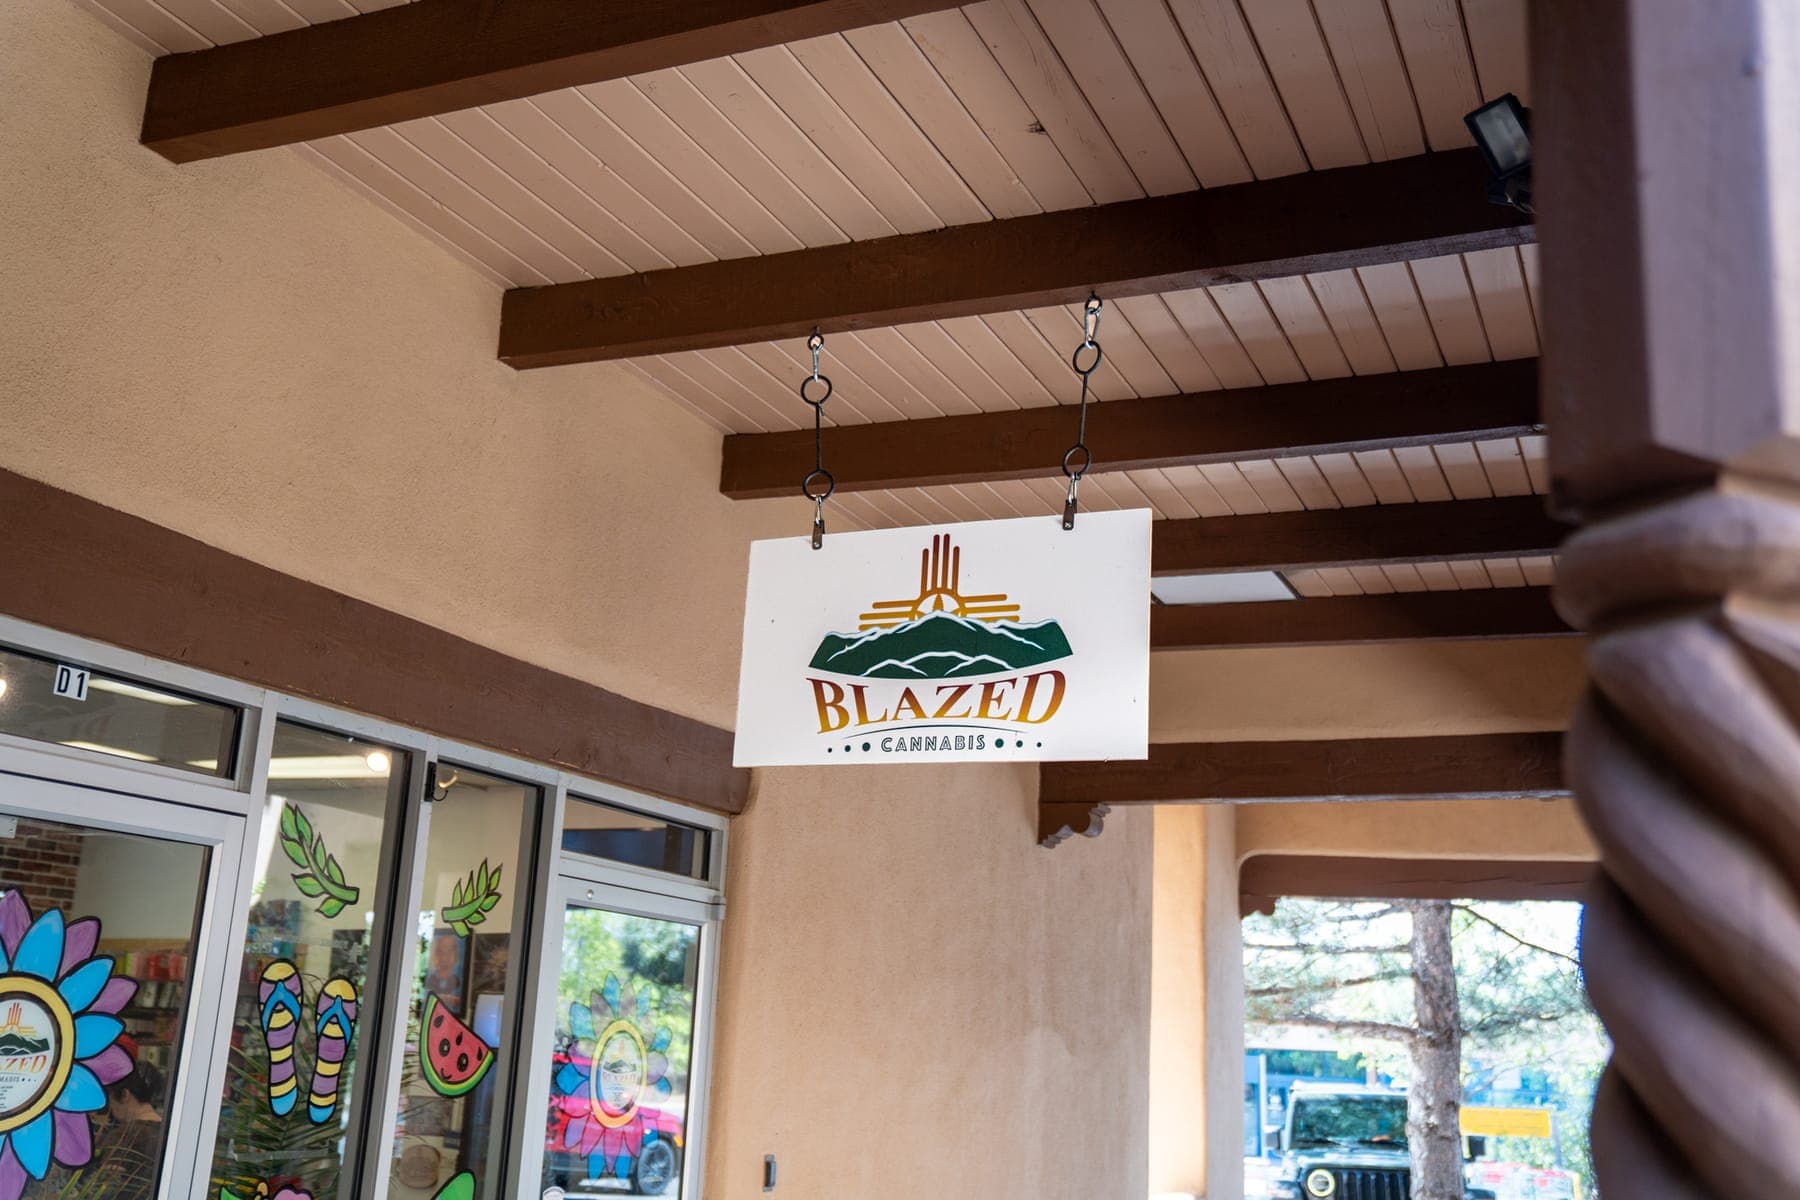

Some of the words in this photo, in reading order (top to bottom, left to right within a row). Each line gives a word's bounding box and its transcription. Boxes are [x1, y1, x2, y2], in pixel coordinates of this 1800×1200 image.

[57, 667, 86, 698] D1
[806, 670, 1067, 734] BLAZED
[881, 735, 986, 752] CANNABIS
[0, 1055, 48, 1072] ZED
